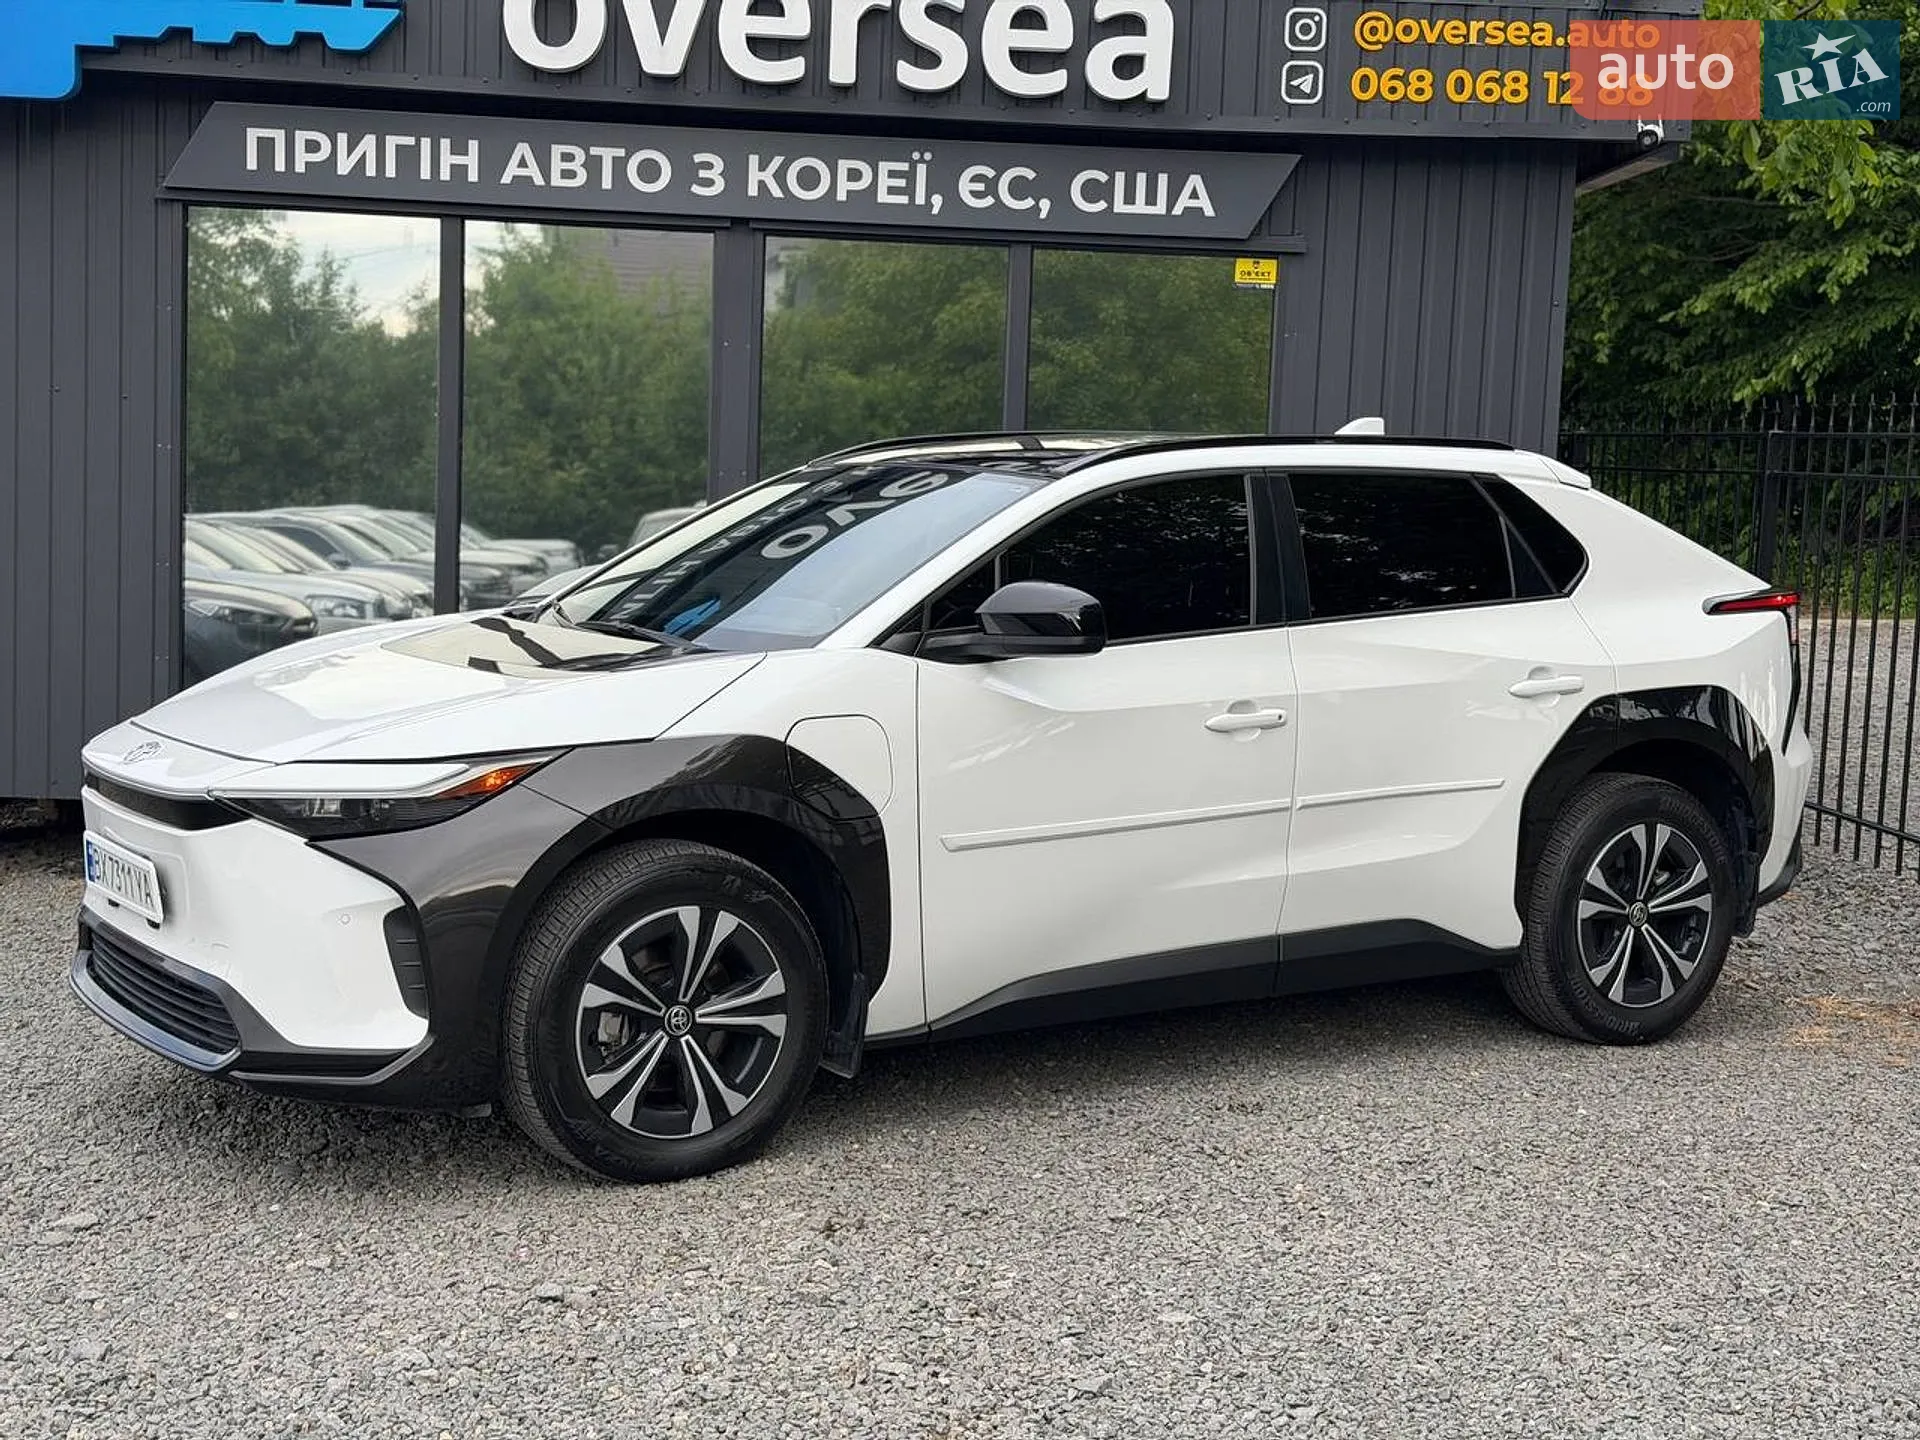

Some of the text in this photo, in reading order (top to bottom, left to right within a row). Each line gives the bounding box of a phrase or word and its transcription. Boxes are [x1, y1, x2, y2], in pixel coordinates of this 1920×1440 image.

[502, 0, 1175, 101] oversea
[1354, 11, 1660, 51] @oversea.auto
[1351, 67, 1434, 103] 068
[1446, 69, 1529, 104] 068
[1543, 71, 1584, 105] 12
[245, 126, 1217, 219] ПРИГІН АВТО З КОРЕЇ, ЄС, США
